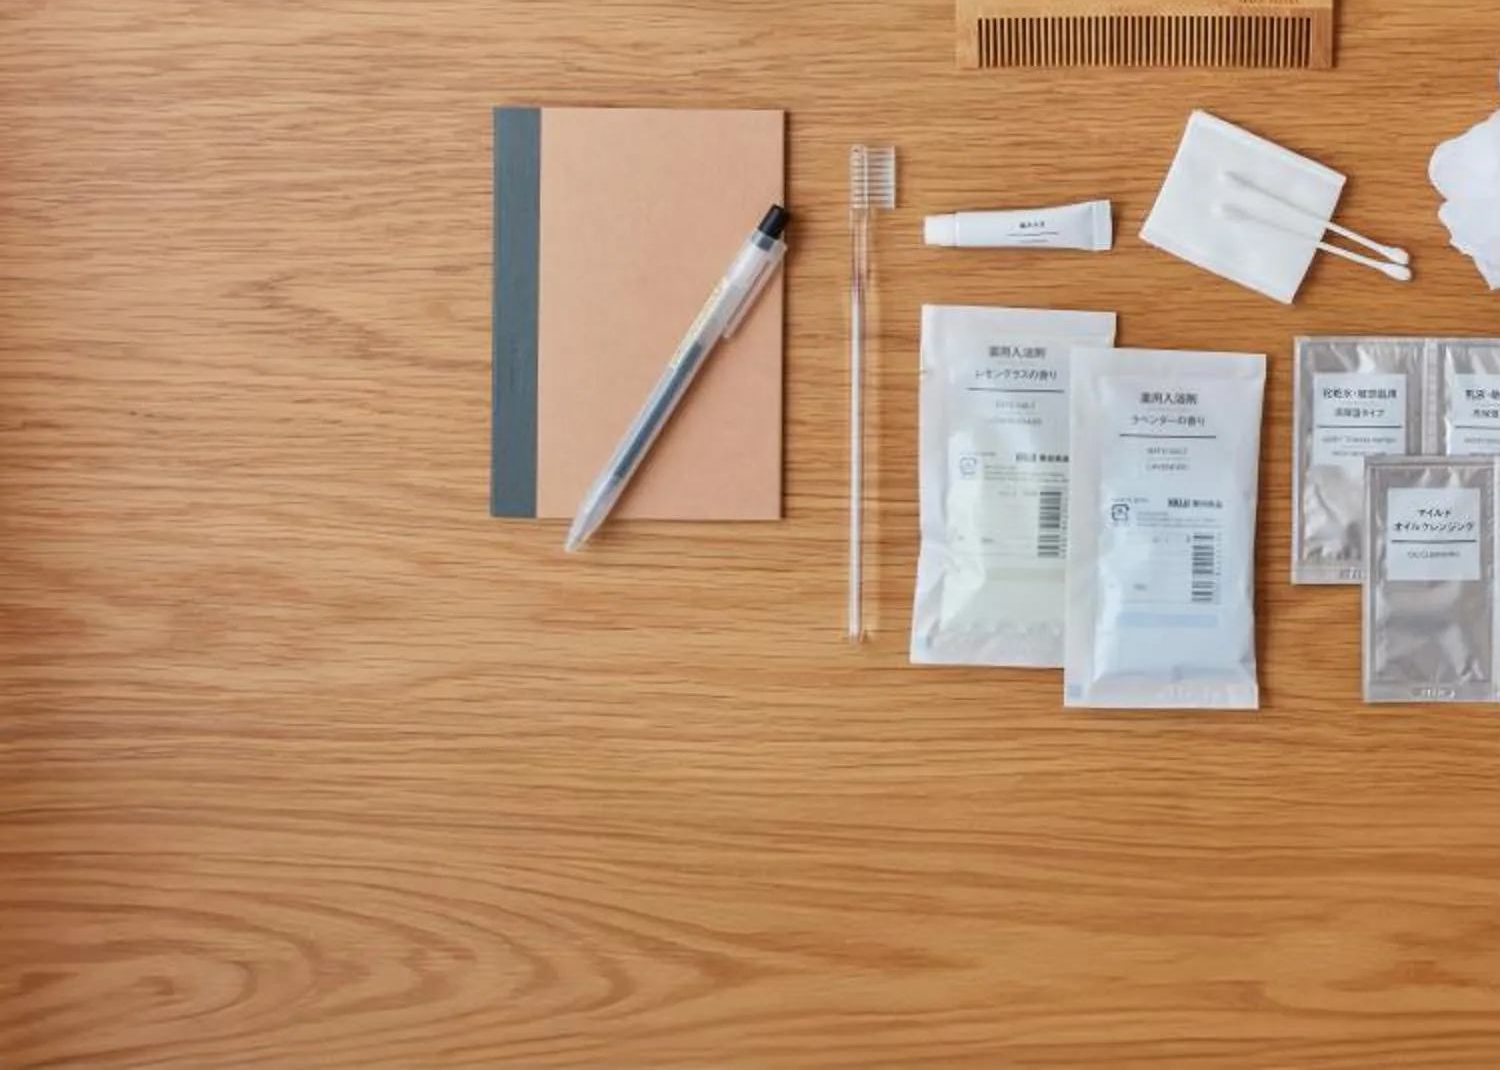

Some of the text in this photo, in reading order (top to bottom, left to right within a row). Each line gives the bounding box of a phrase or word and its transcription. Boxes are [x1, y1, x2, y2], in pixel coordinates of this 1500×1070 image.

[975, 368, 1058, 380] レモングラスの香り
[1131, 415, 1205, 427] ラベンダーの香り
[1393, 521, 1475, 532] オイルクレンジング
